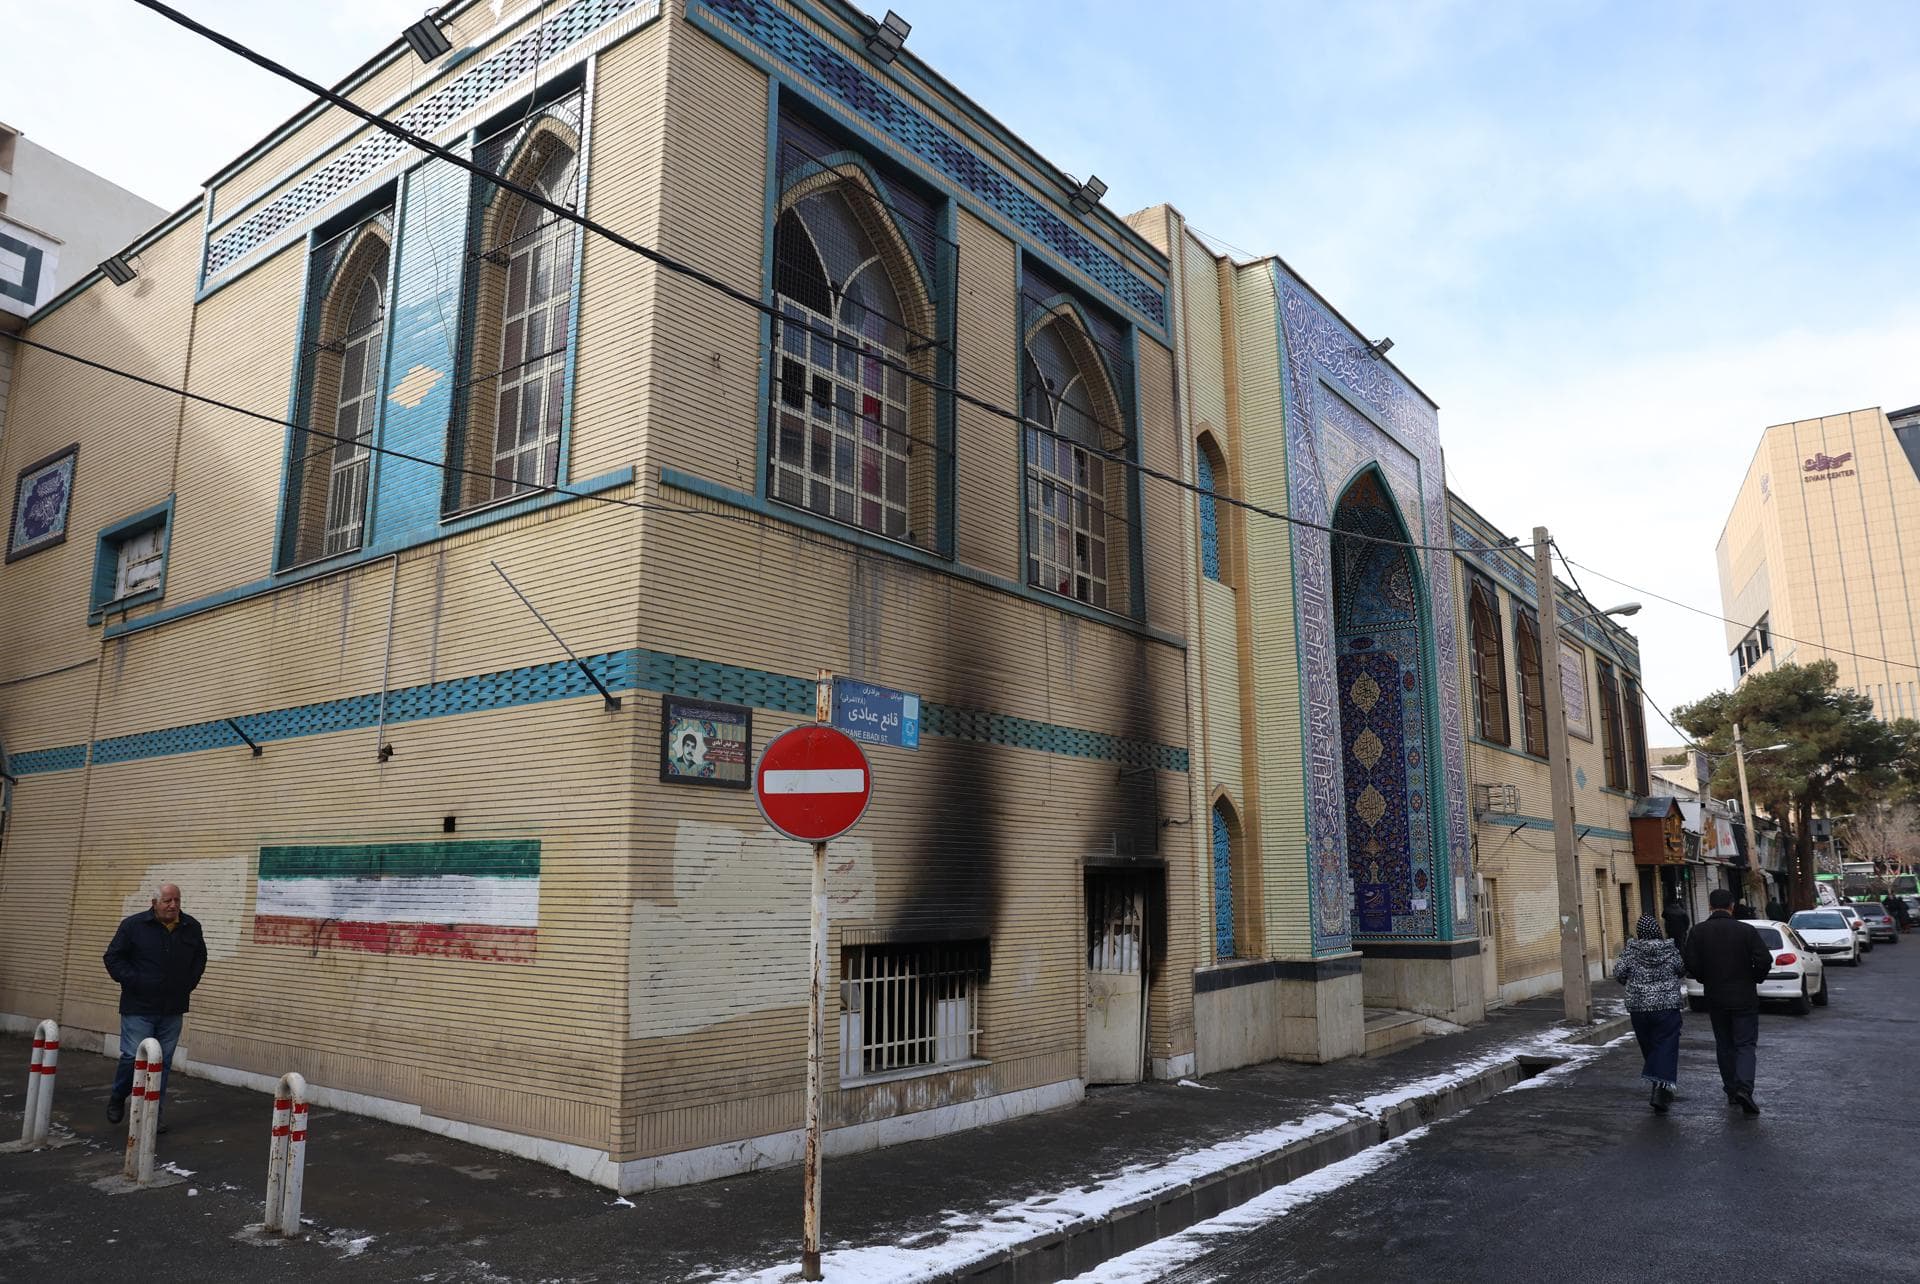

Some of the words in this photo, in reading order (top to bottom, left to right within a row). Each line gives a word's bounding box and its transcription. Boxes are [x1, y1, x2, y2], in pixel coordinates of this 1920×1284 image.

[848, 707, 878, 725] عبادی
[880, 712, 898, 731] قانع
[862, 731, 880, 741] EBADI
